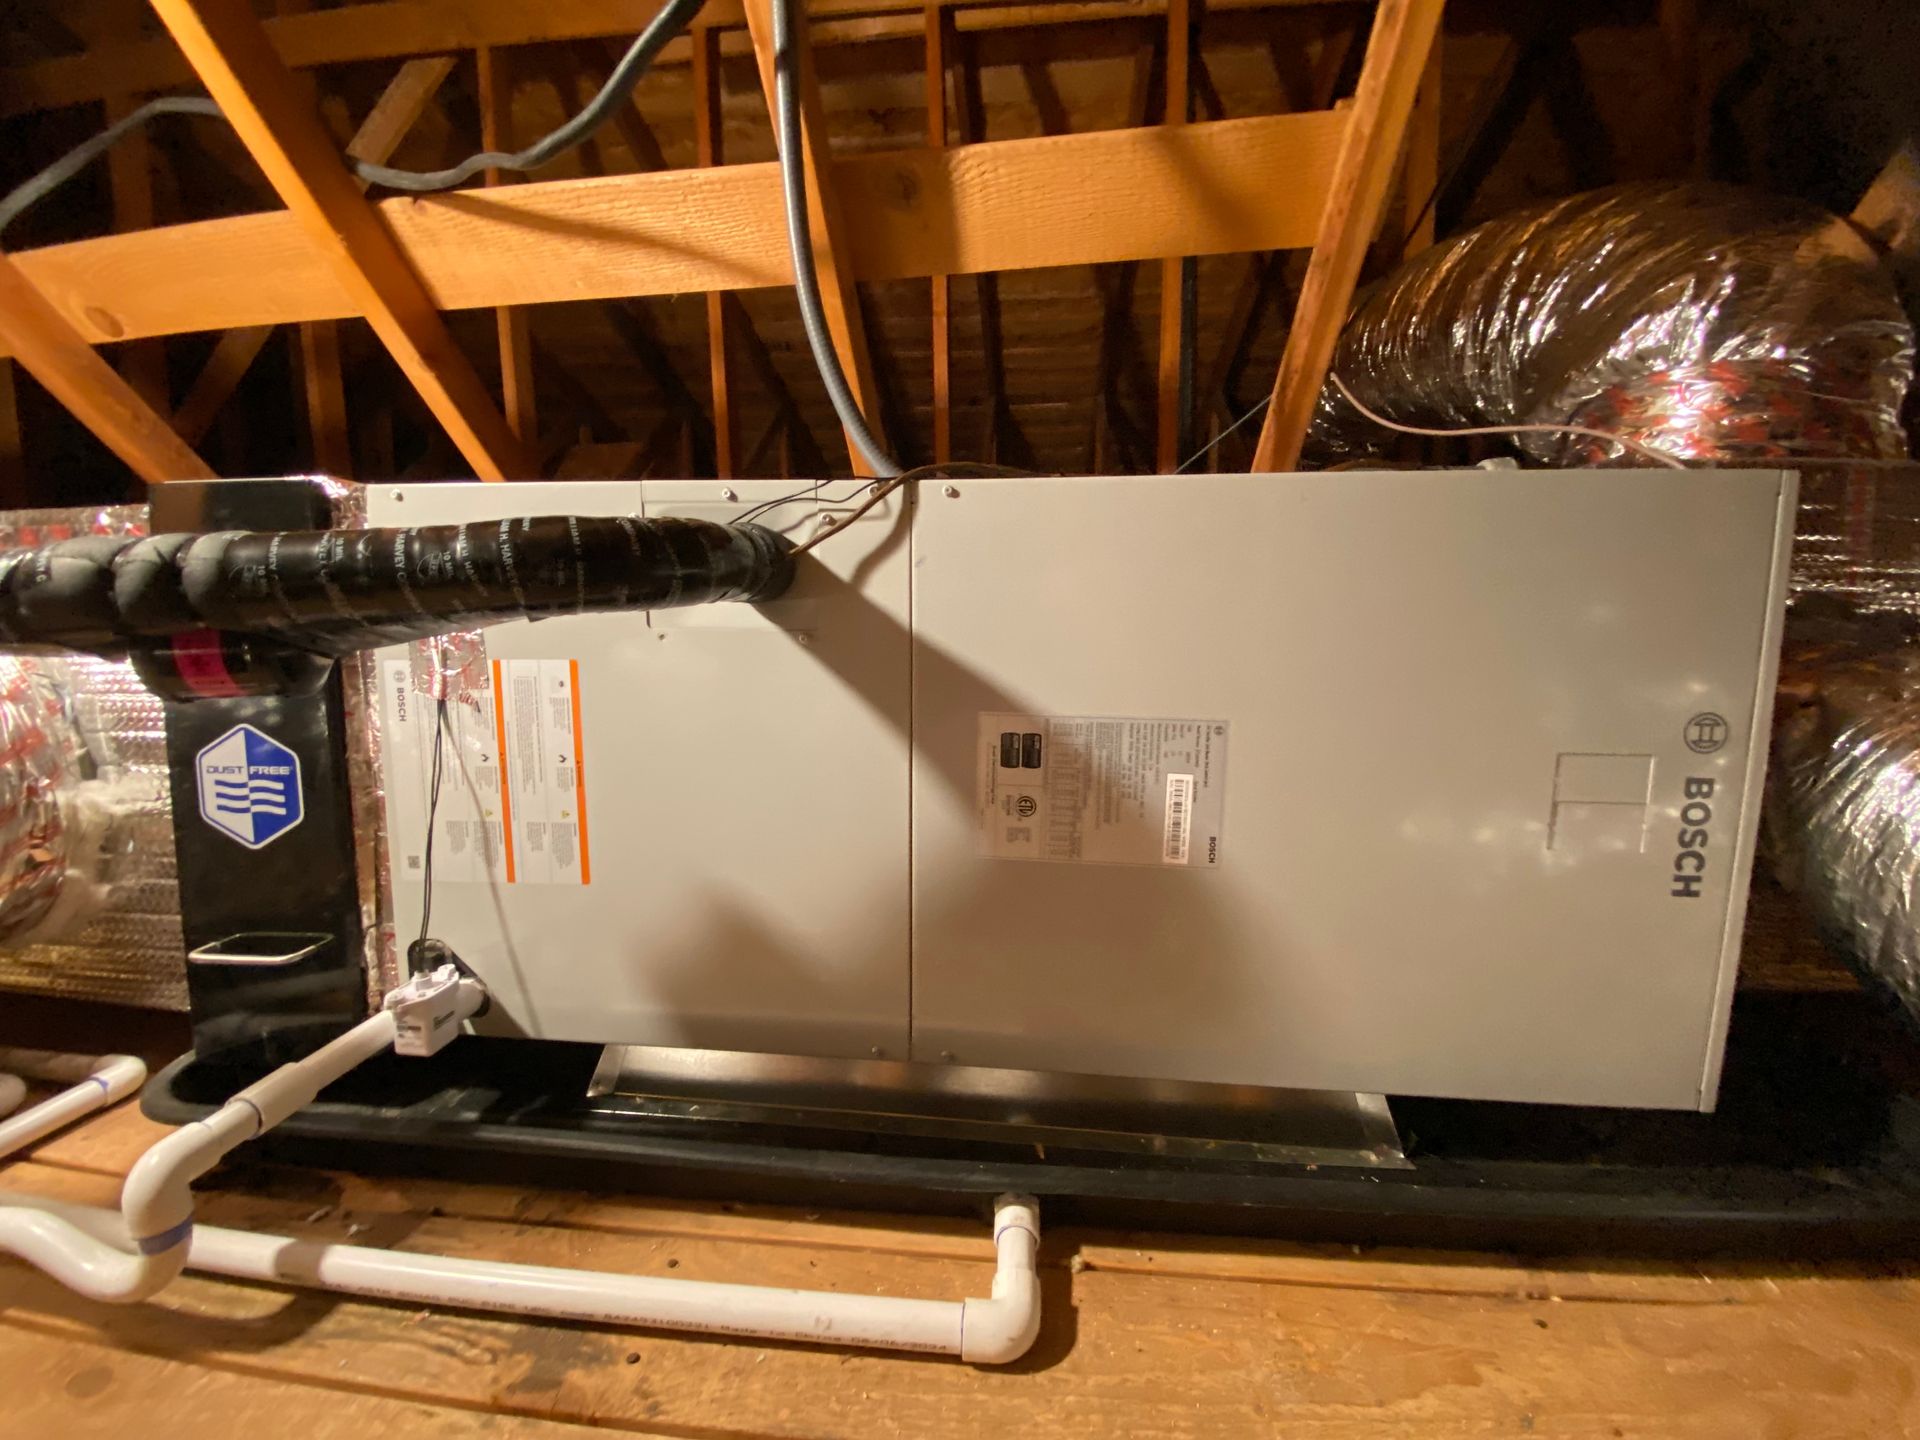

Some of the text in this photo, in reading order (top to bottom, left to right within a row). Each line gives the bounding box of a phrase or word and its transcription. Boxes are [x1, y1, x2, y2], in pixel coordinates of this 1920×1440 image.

[394, 533, 407, 568] HARVEY
[442, 551, 452, 560] 10
[397, 687, 407, 722] BOSCH
[206, 766, 244, 774] DUST
[1208, 836, 1217, 864] BOSCH
[1671, 776, 1716, 898] BOSCH
